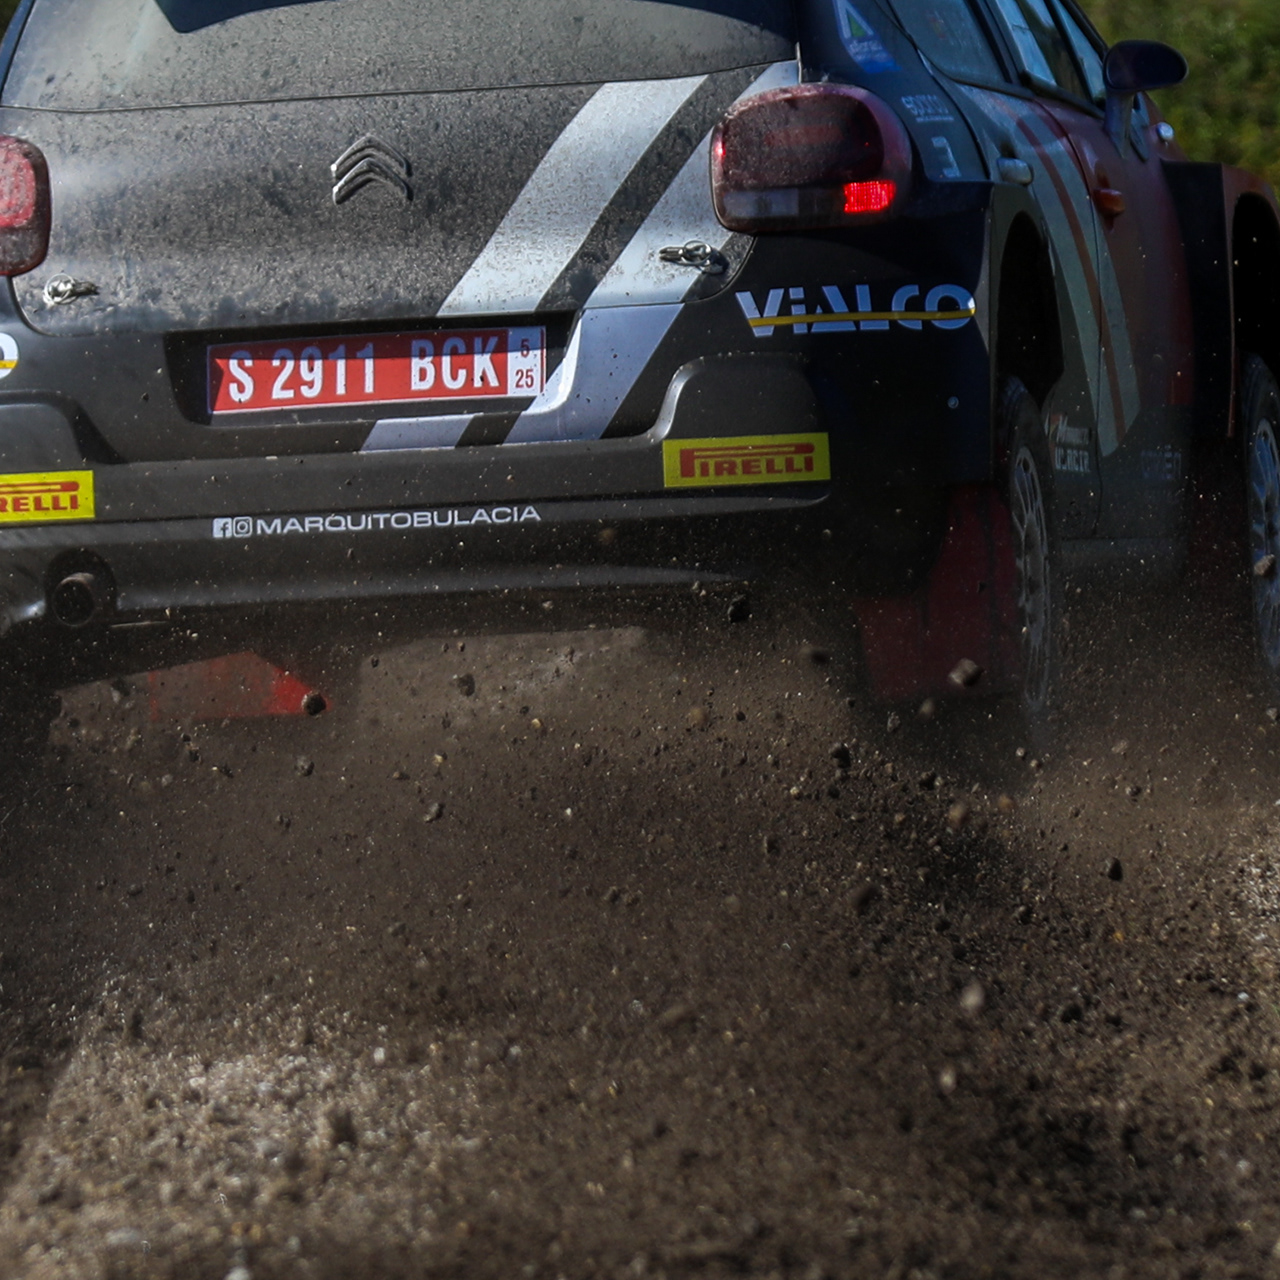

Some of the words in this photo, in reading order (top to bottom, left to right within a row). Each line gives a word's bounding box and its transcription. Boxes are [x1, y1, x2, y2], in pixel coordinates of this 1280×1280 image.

[520, 338, 530, 358] 5
[228, 350, 254, 403] S
[271, 342, 375, 400] 2911
[410, 335, 499, 392] BCK
[515, 368, 535, 390] 25
[680, 442, 815, 478] PIRELLI
[256, 505, 542, 536] MARQUITOBULACIA
